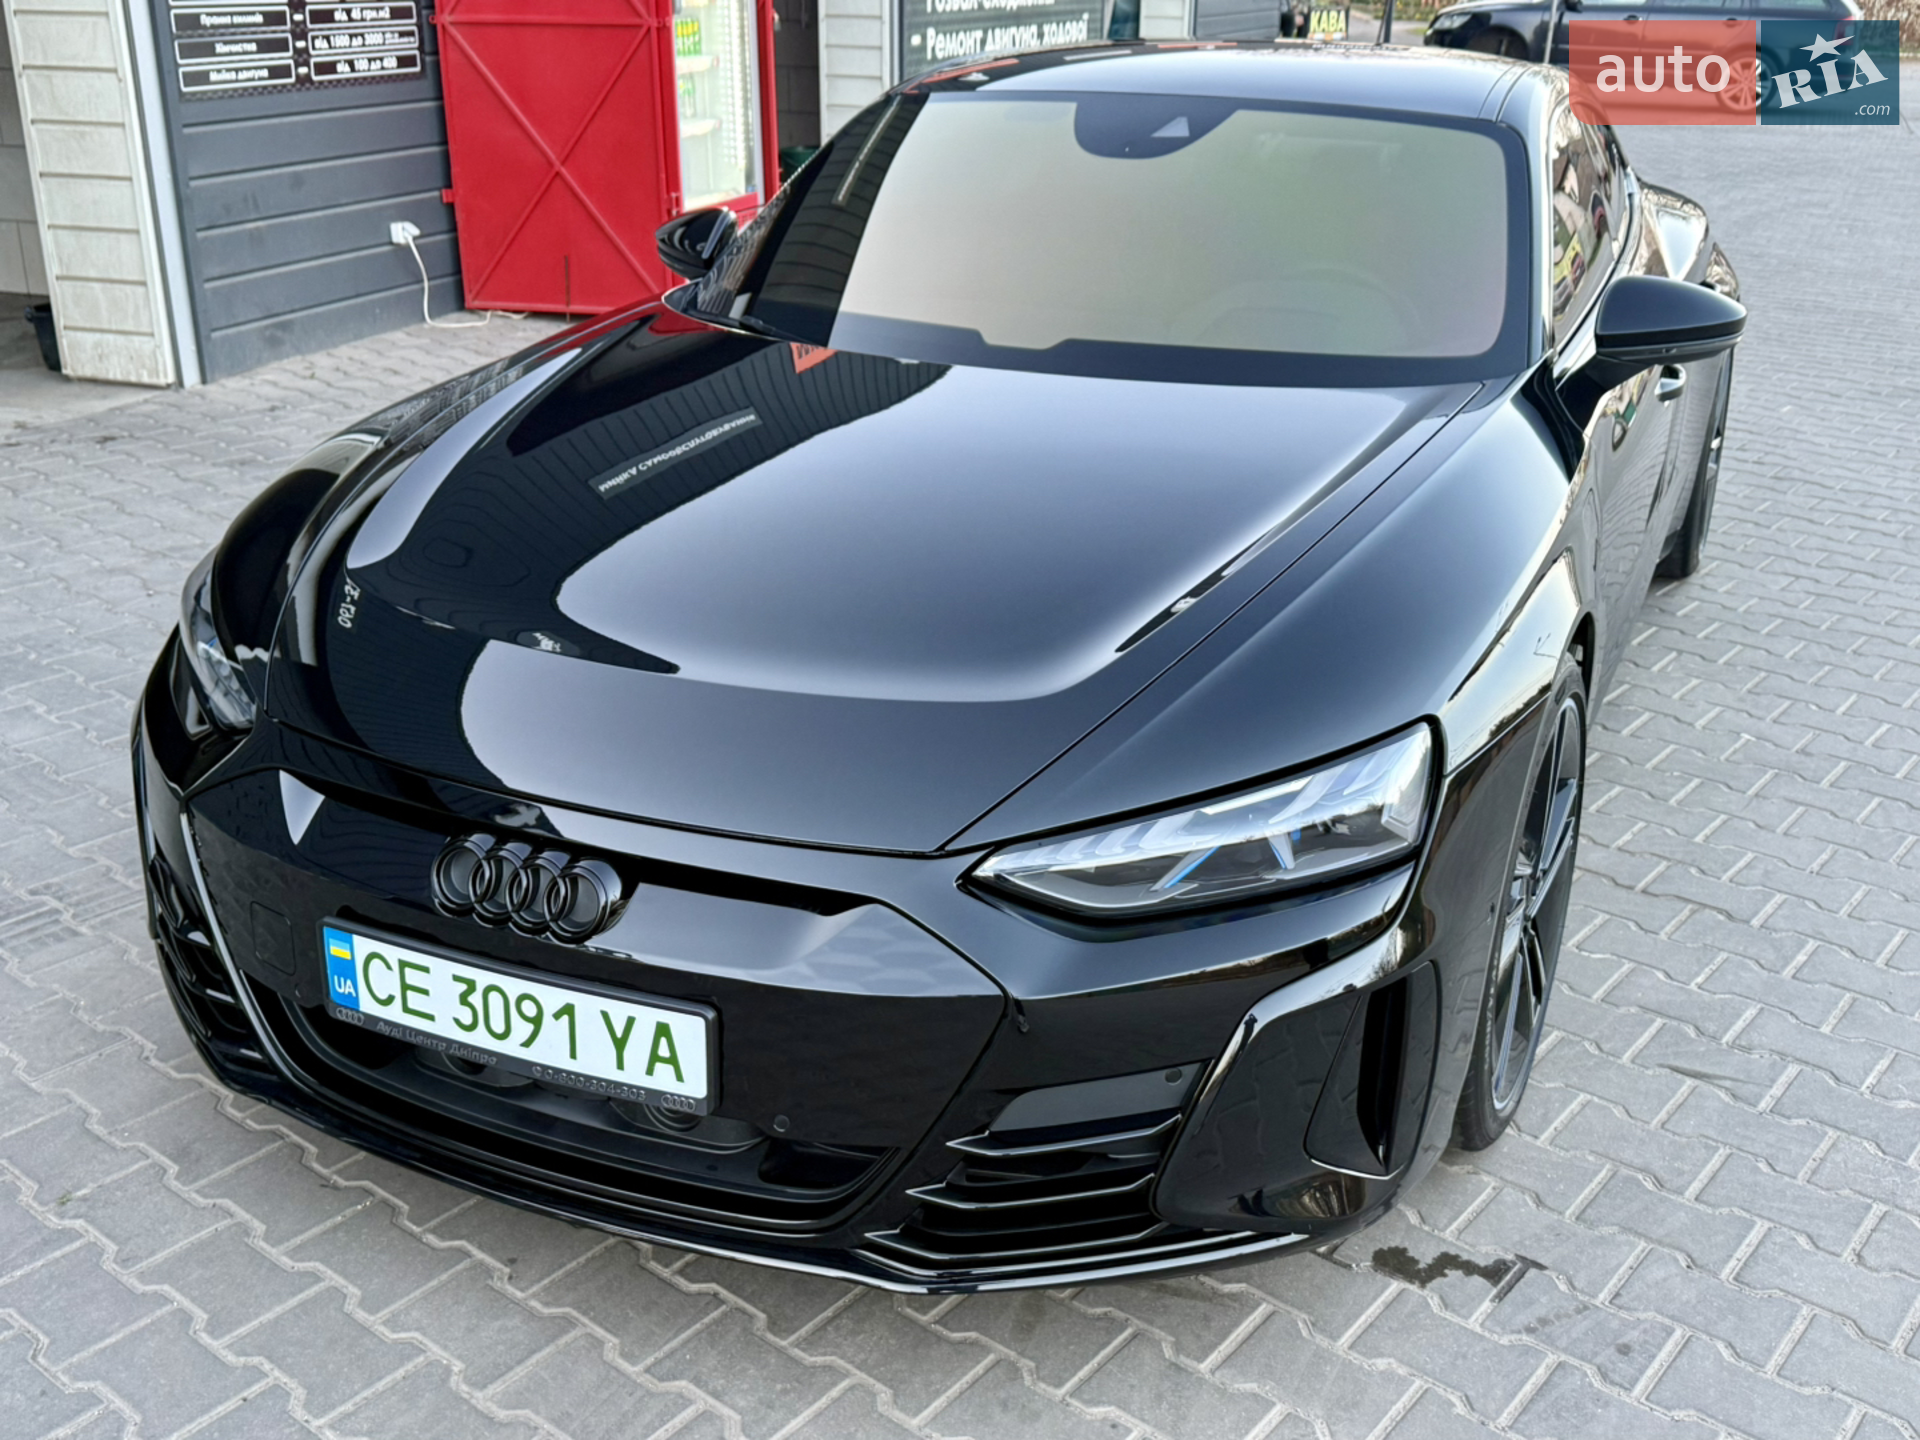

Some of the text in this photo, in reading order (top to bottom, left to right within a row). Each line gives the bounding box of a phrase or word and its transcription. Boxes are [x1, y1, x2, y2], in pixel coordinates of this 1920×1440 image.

[926, 26, 984, 61] Ремонт
[1042, 12, 1090, 45] ходової
[334, 975, 356, 998] UA
[362, 951, 685, 1083] CE 3091 YA
[377, 1020, 498, 1065] Ауді Центр Дніпро
